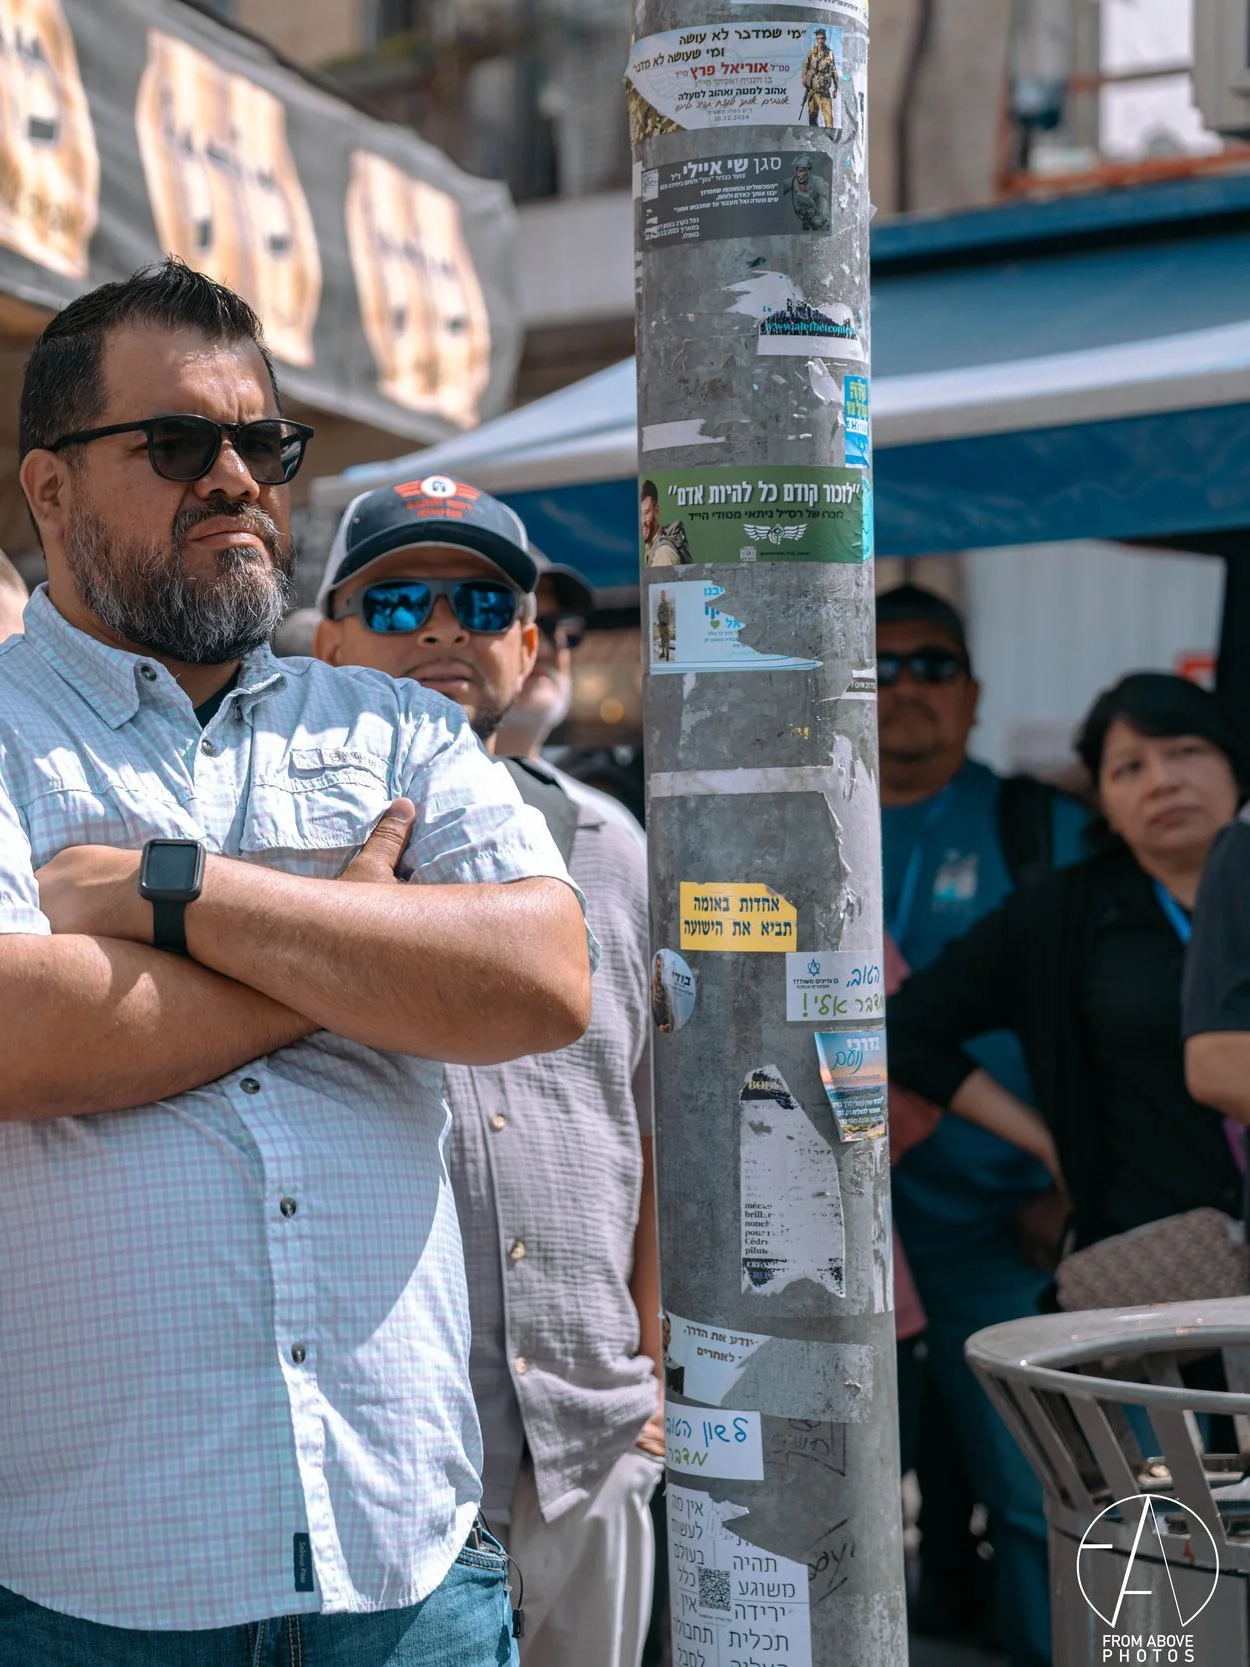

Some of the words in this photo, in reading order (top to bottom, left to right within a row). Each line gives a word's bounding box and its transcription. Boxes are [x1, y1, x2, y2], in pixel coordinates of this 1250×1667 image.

[679, 33, 707, 45] עושה
[711, 27, 729, 41] לא
[735, 28, 782, 40] שמדבר
[652, 52, 665, 67] לא
[667, 49, 702, 63] שעושה
[706, 47, 725, 58] ומי
[632, 60, 651, 73] מדבר
[690, 64, 716, 80] פרץ
[720, 62, 768, 74] אוריאל
[678, 89, 706, 101] למעלה
[708, 88, 734, 98] ואהוב
[735, 86, 763, 96] למטה
[764, 87, 787, 95] אהוב
[682, 160, 723, 179] איילי
[727, 158, 749, 173] שי
[753, 156, 782, 175] סגן
[668, 484, 704, 506] אדם"
[708, 480, 752, 504] להיות
[757, 480, 778, 502] כל
[783, 483, 819, 507] קודם
[822, 482, 861, 504] "לזכור
[712, 509, 742, 519] מטודי
[744, 509, 774, 519] ניתאי
[804, 508, 820, 519] של
[693, 896, 731, 913] באומה
[739, 896, 780, 913] אחדות
[683, 919, 724, 937] הישועה
[731, 920, 752, 936] את
[760, 920, 793, 938] תביא
[710, 1332, 727, 1343] את
[696, 1346, 735, 1362] לאחרים
[702, 1416, 749, 1448] לשון
[686, 1498, 704, 1519] אין
[671, 1517, 703, 1540] לעשות
[673, 1541, 705, 1566] בעולם
[733, 1555, 778, 1573] תהיה
[677, 1566, 696, 1587] כלל
[738, 1580, 796, 1599] משוגע
[680, 1593, 698, 1616] אין
[734, 1603, 786, 1623] ירידה
[728, 1628, 789, 1651] תכלית
